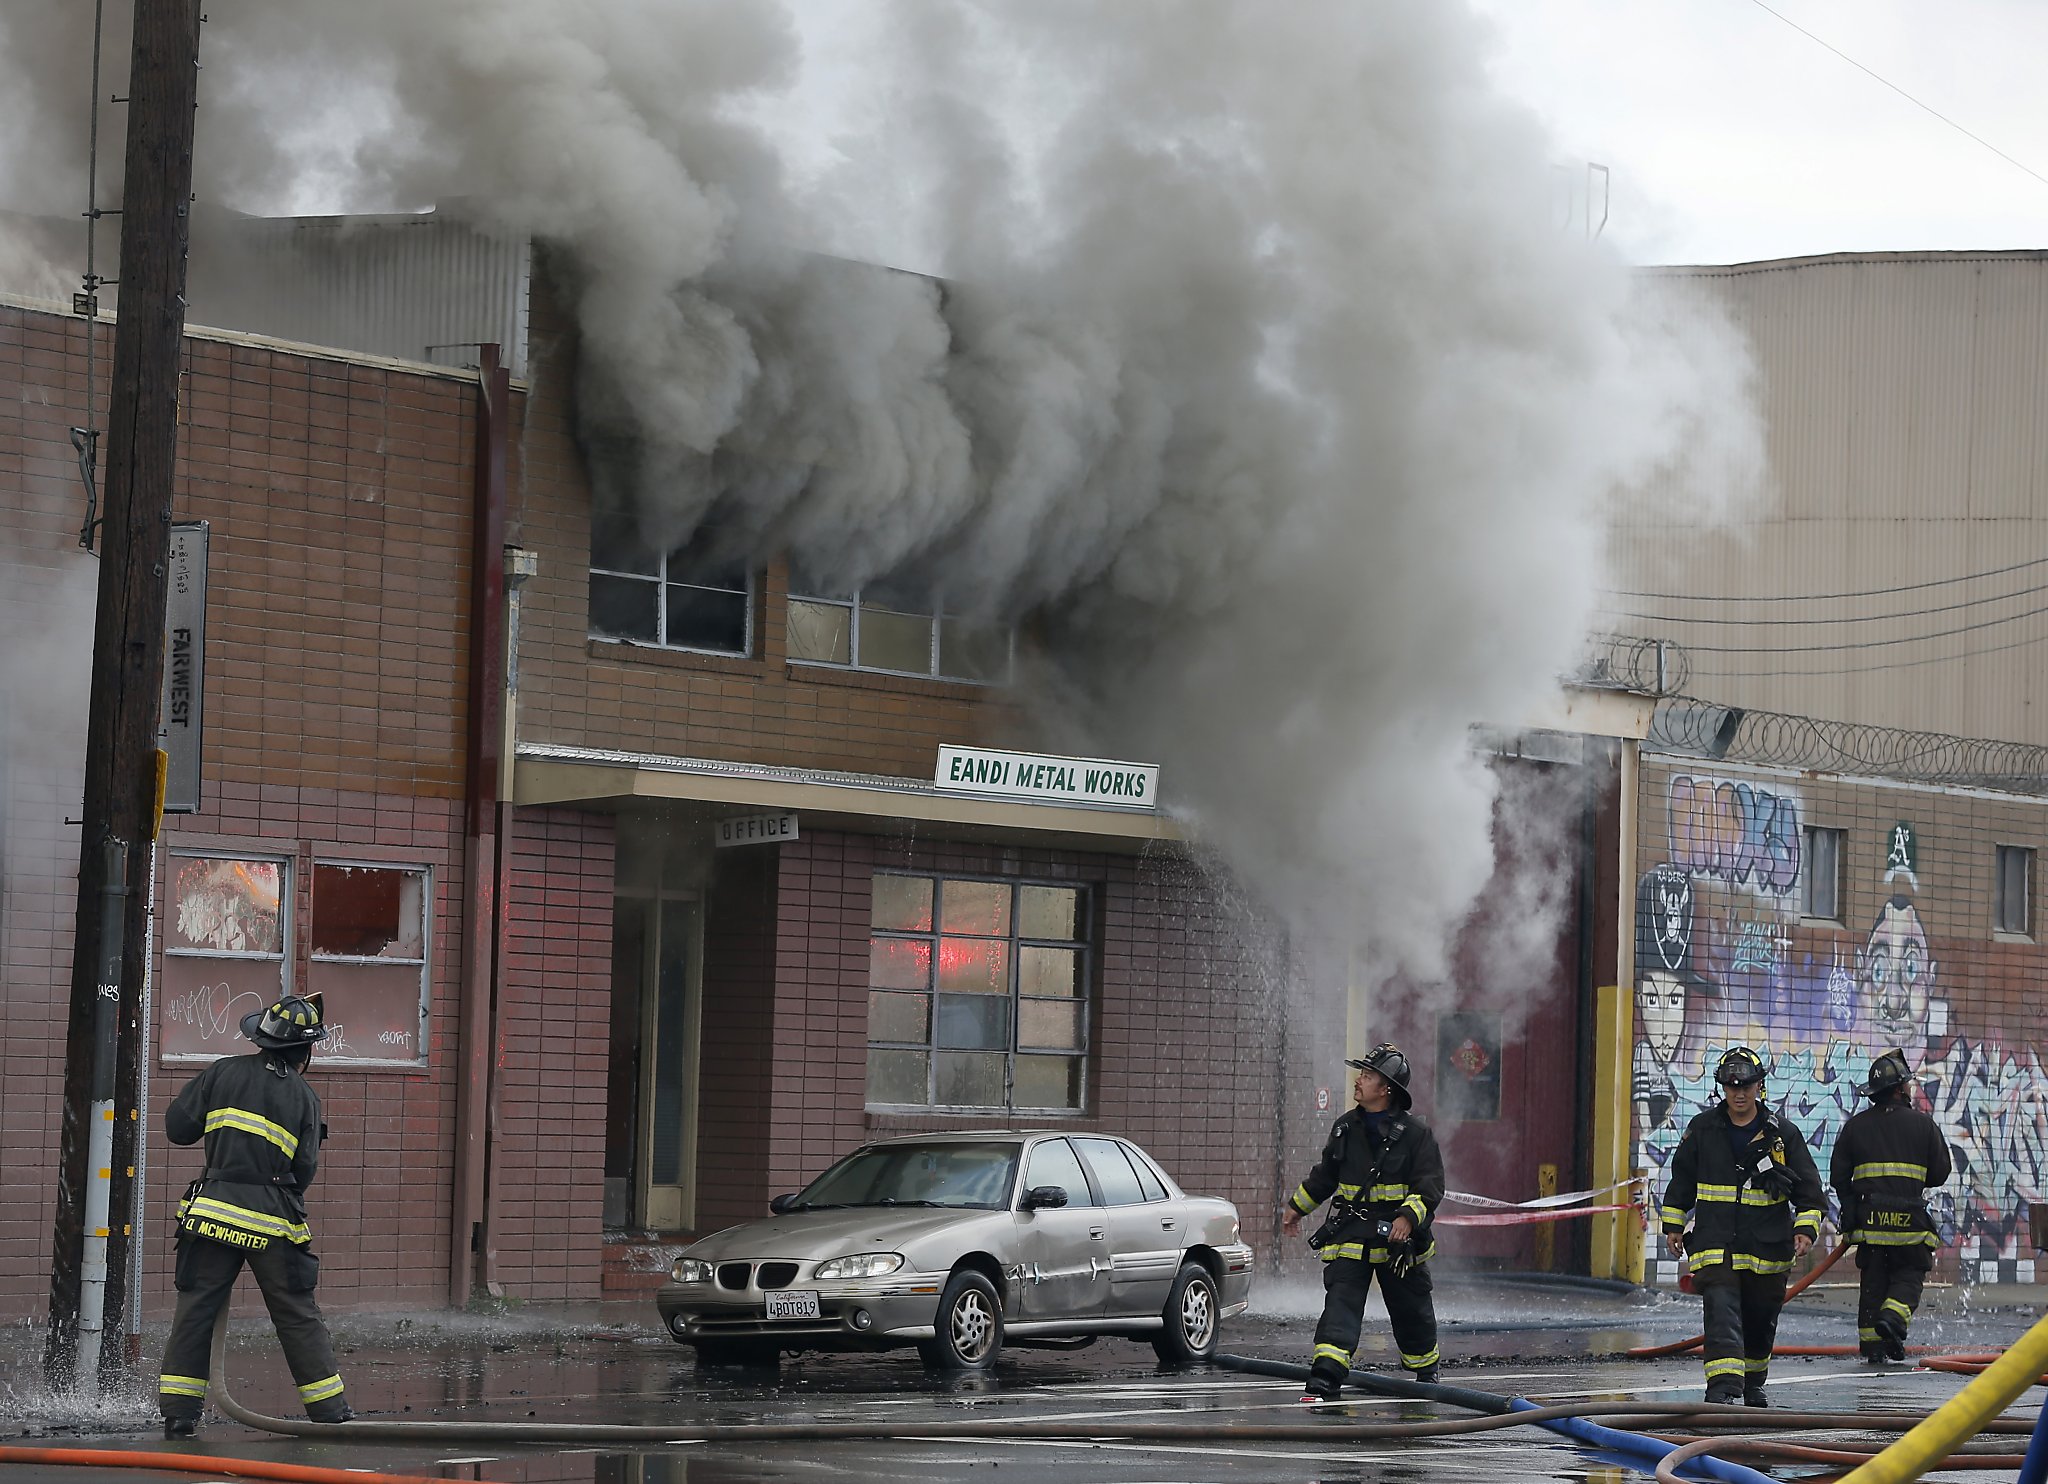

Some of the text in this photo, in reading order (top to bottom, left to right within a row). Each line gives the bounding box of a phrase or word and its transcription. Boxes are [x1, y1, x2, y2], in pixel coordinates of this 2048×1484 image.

[171, 628, 191, 728] FARWEST
[950, 756, 1146, 798] EANDI METAL WORKS
[722, 817, 789, 840] OFFICE
[1867, 1211, 1912, 1227] J YANEZ
[198, 1220, 269, 1250] MCWHORTER
